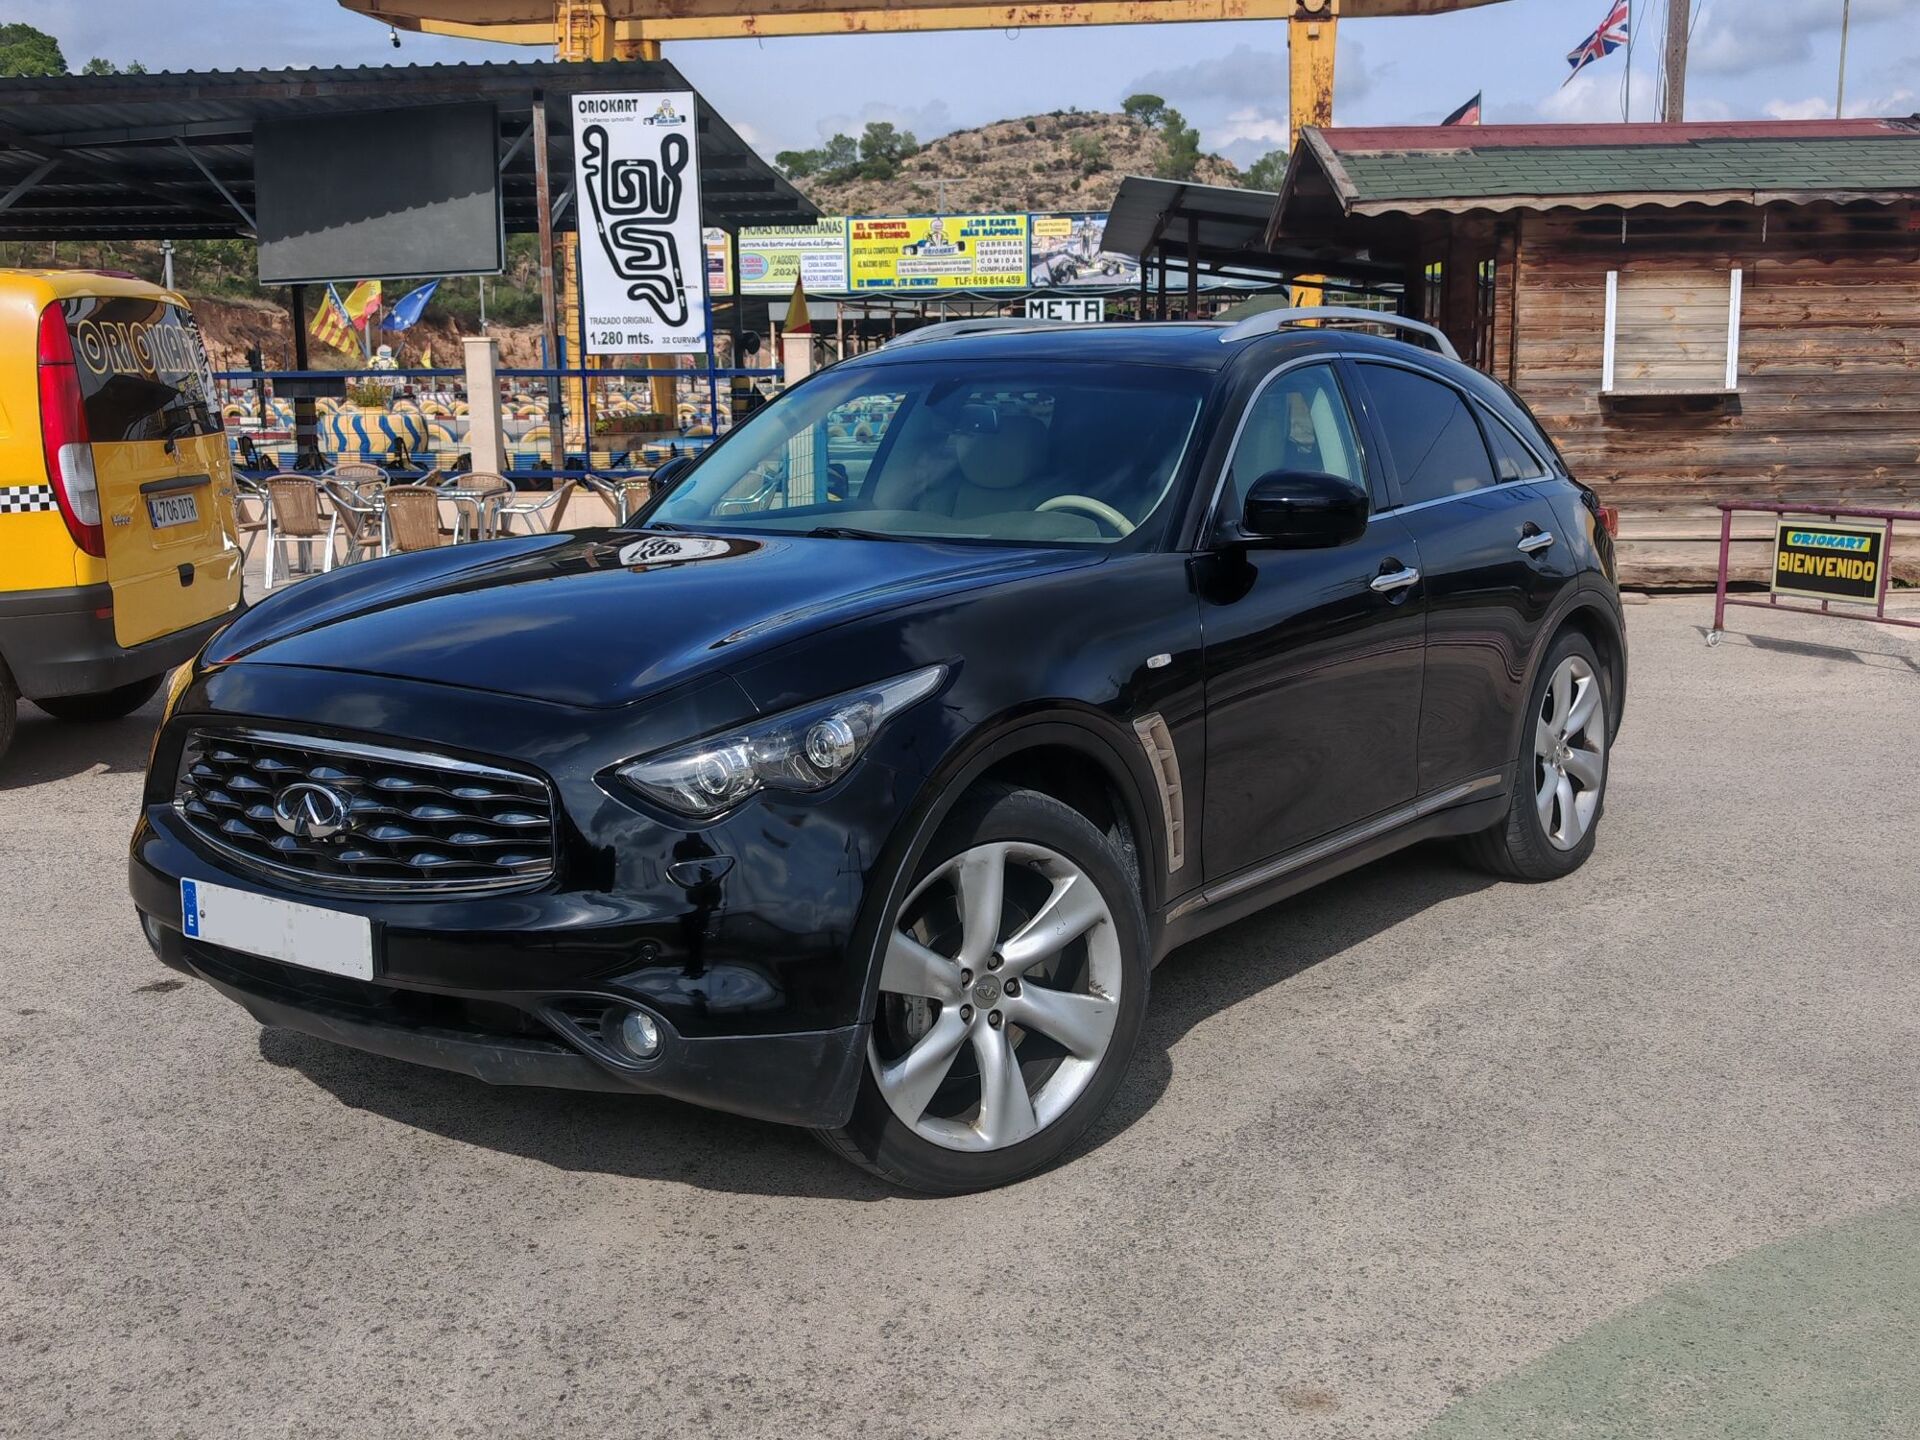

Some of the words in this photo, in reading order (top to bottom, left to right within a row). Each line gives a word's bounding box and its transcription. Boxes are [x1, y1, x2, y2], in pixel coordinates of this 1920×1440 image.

[578, 99, 638, 114] ORIOKART
[853, 231, 872, 239] MÁS
[874, 230, 910, 239] TÉCNICO
[961, 228, 979, 236] MÁS
[982, 228, 1022, 236] RÁPIDOS!
[773, 267, 798, 276] 2024
[980, 264, 1022, 272] CUMPLEAÑOS
[954, 276, 972, 285] TLF:
[1006, 275, 1020, 284] 459
[1029, 300, 1100, 320] META
[590, 317, 621, 325] TRAZADO
[623, 316, 654, 325] ORIGINAL
[590, 331, 623, 345] 1.280
[627, 332, 654, 345] mts.
[662, 336, 672, 344] 32
[672, 336, 700, 344] CURVAS
[179, 498, 197, 519] DTR
[1792, 533, 1866, 549] ORIOKART
[1778, 551, 1875, 582] BIENVENIDO
[188, 914, 195, 927] E
